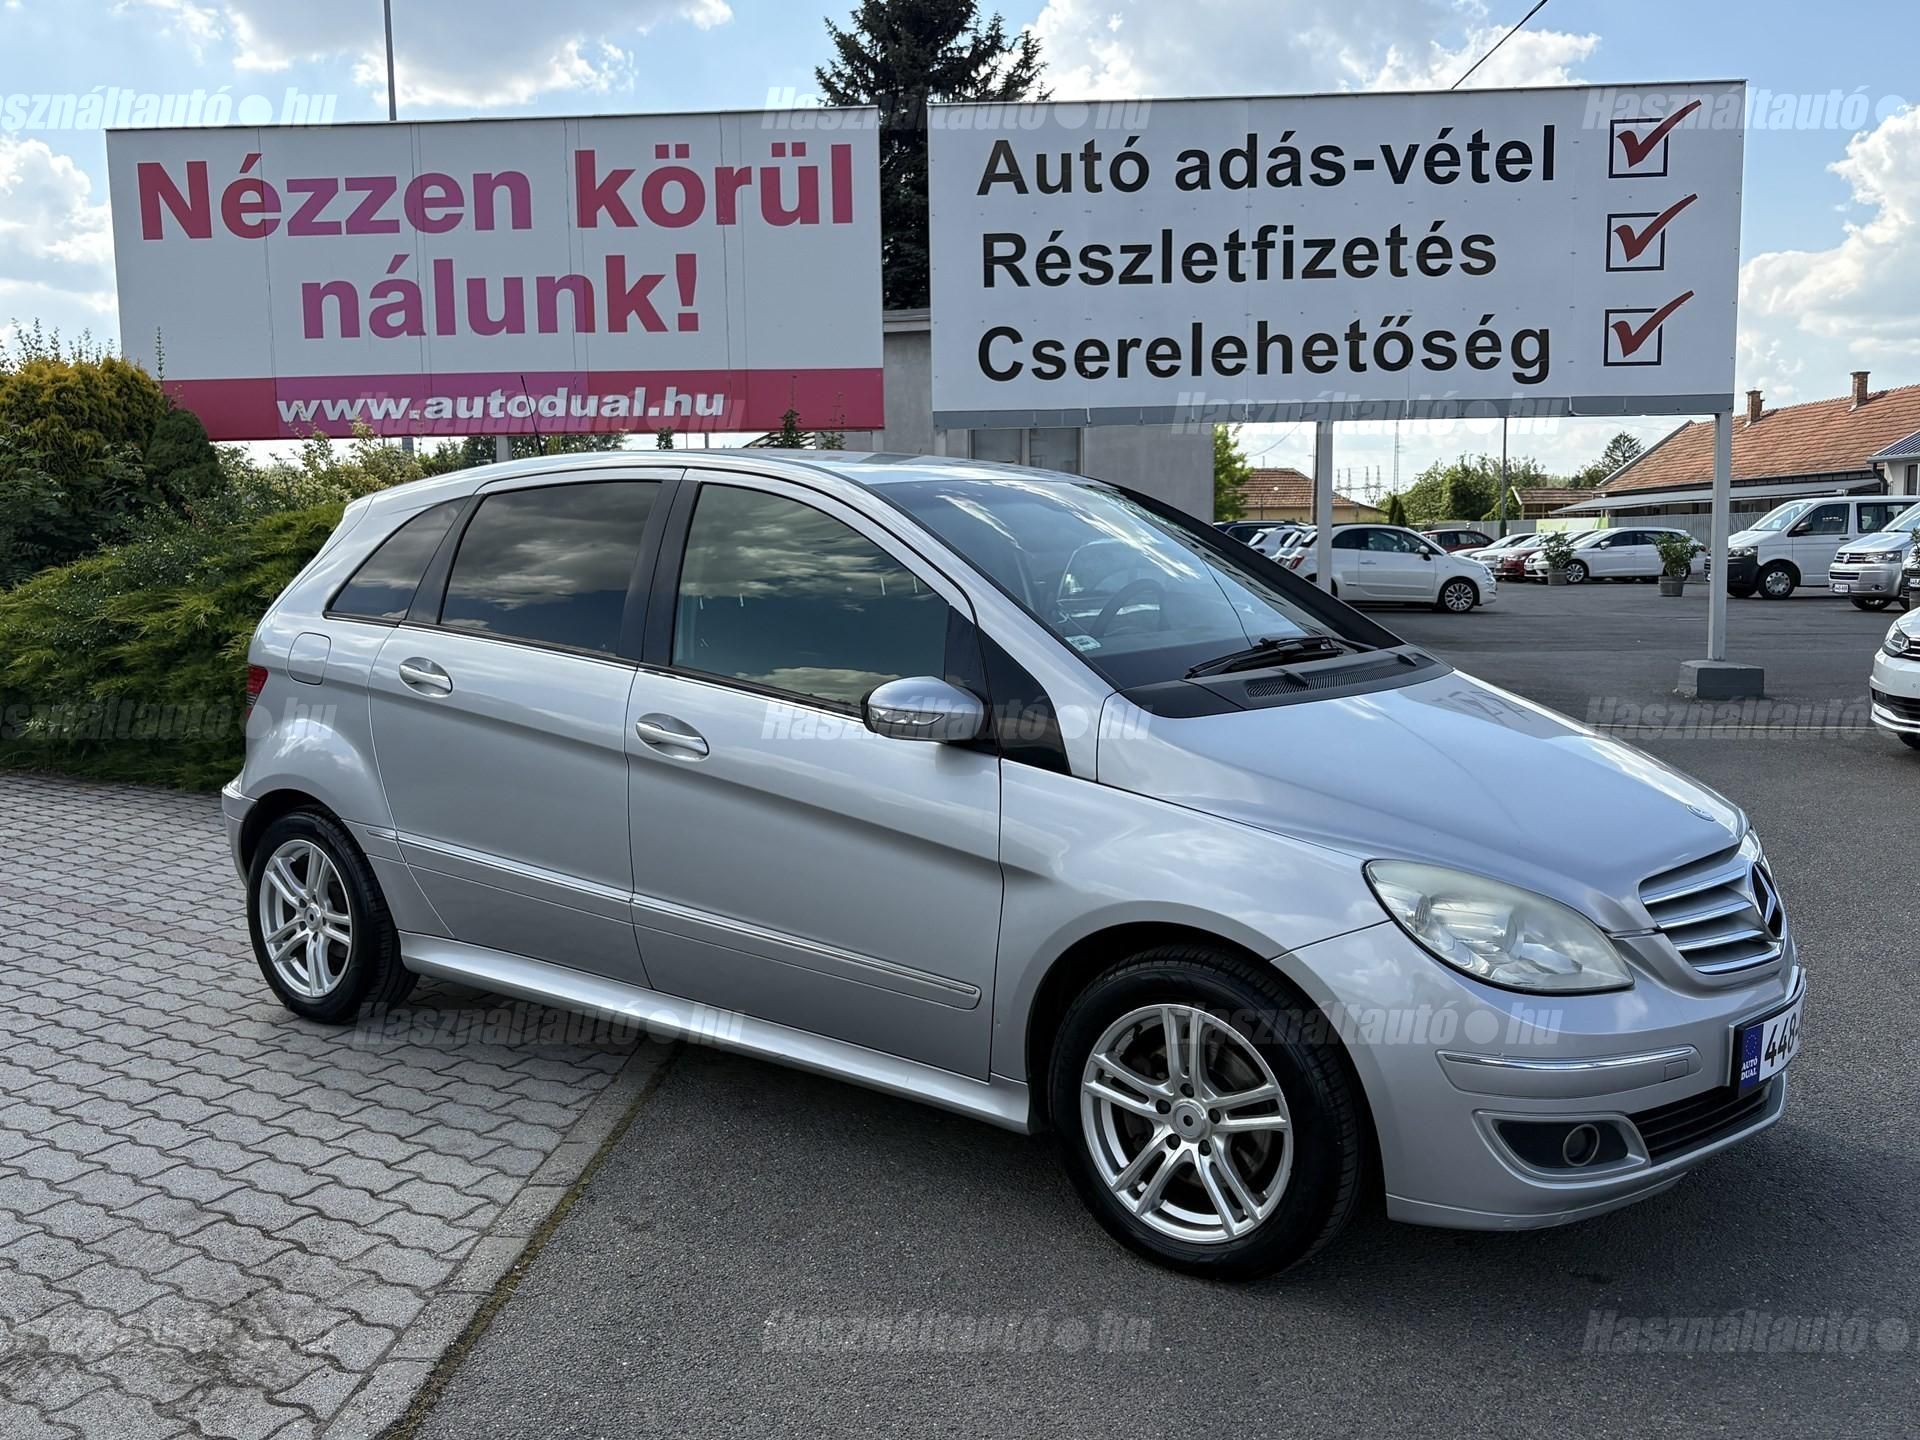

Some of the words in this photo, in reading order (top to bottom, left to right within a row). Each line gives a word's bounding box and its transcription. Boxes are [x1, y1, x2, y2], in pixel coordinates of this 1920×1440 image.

[139, 154, 533, 242] Nézzen
[577, 143, 853, 229] körül
[976, 135, 1150, 196] Autó
[1175, 124, 1556, 192] adás-vétel
[982, 220, 1498, 289] Részletfizetés
[302, 254, 699, 339] nálunk!
[978, 313, 1551, 386] Cserelehetőség
[276, 386, 725, 423] www.autodual.hu
[1740, 1068, 1757, 1081] DUAL
